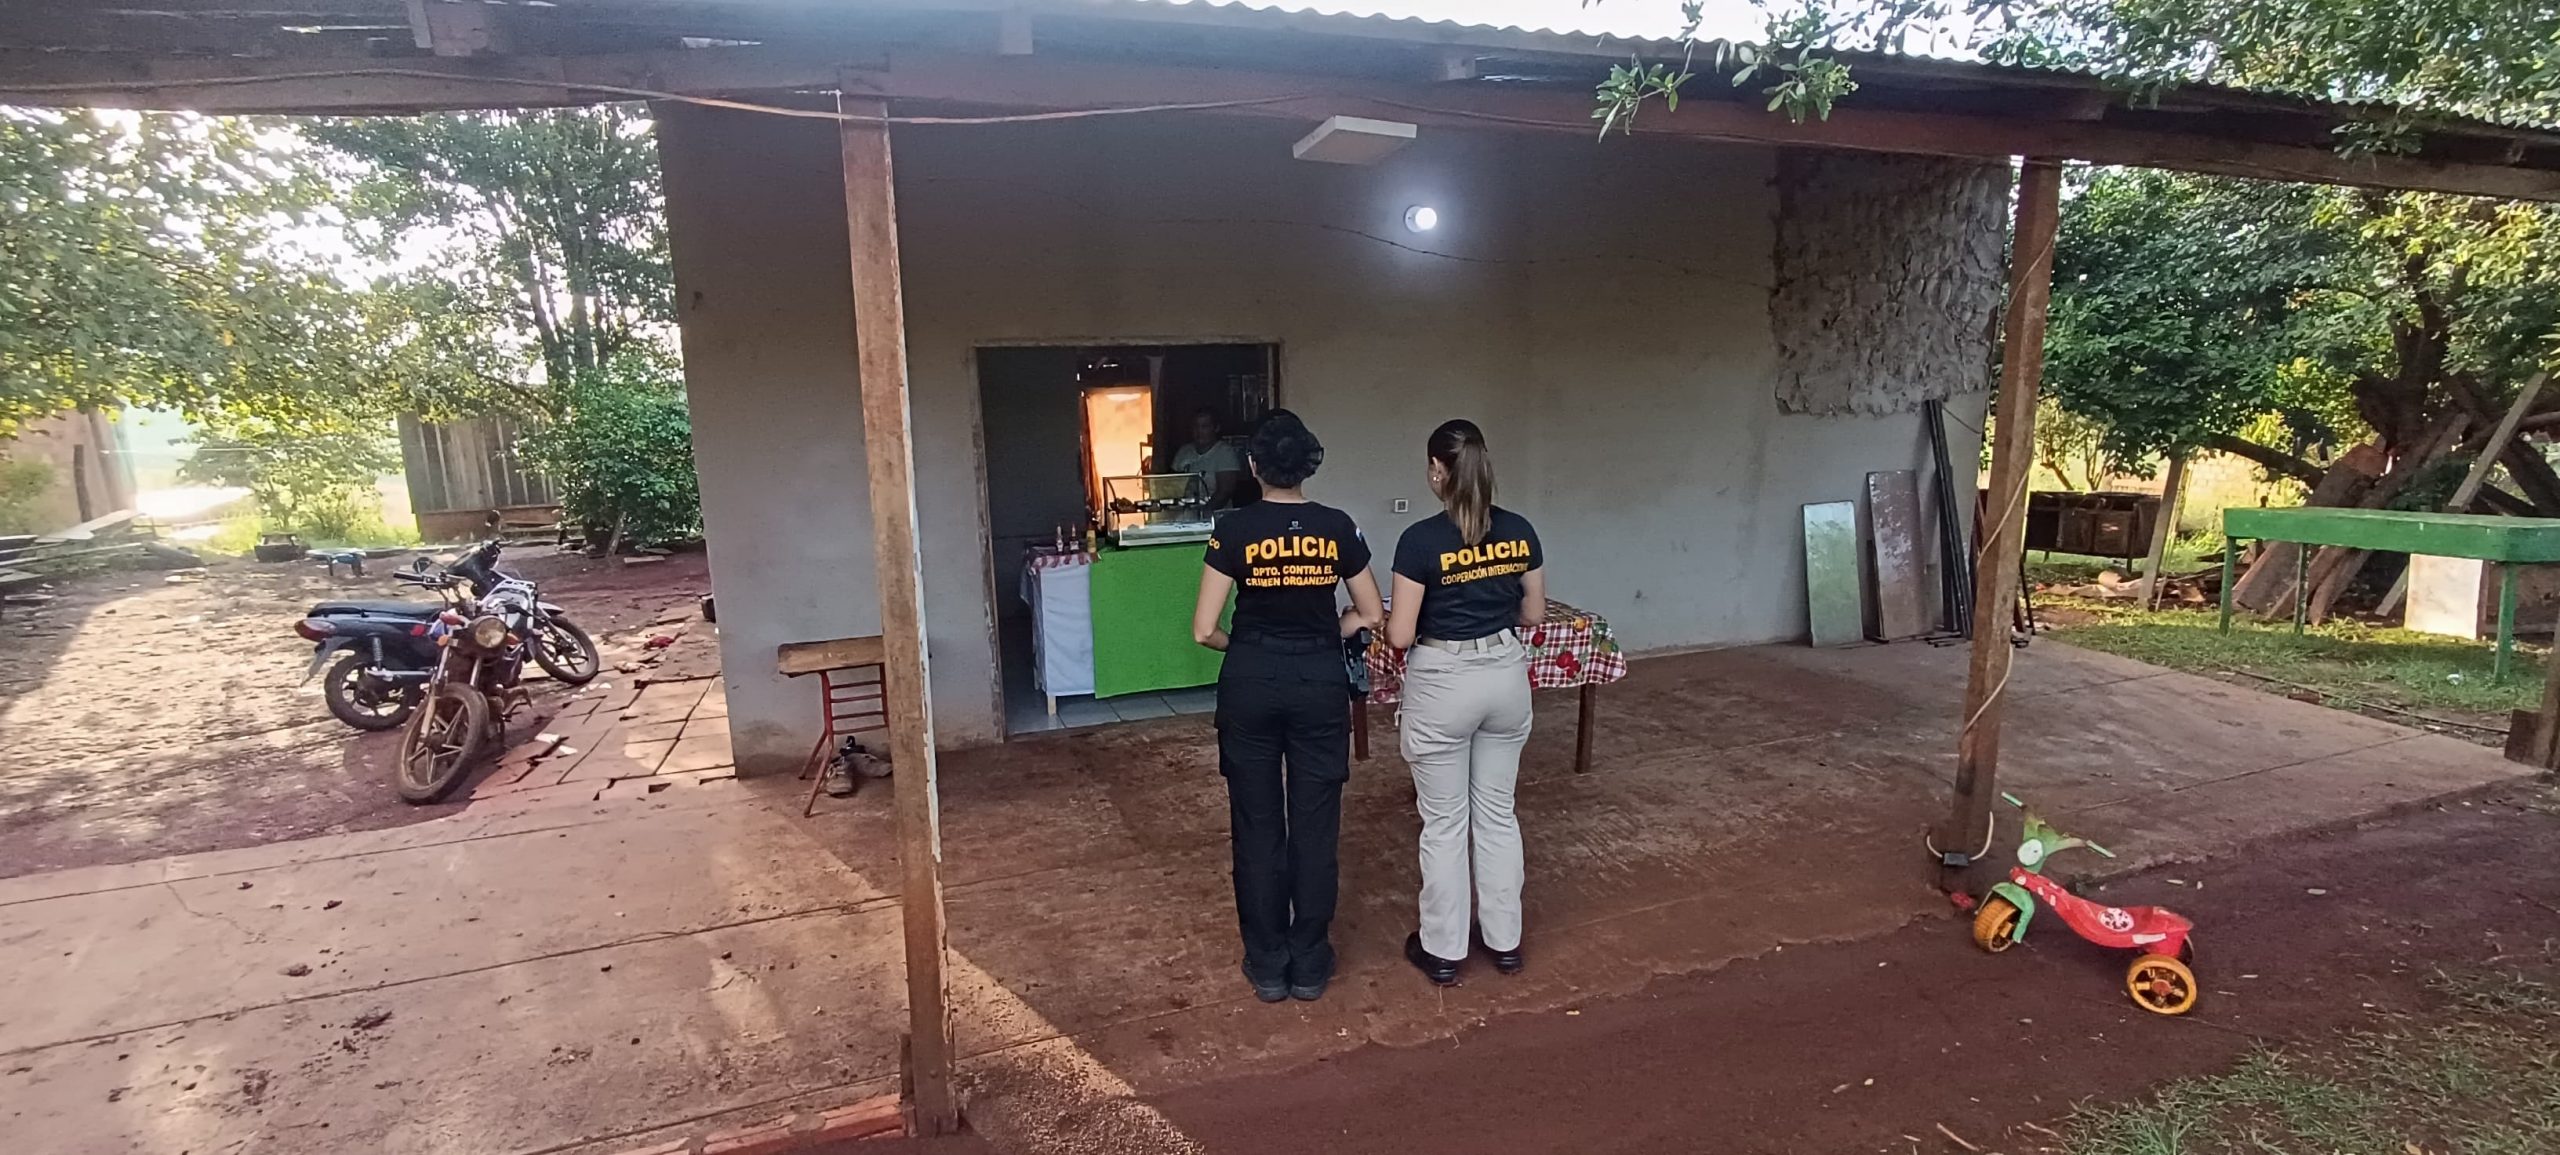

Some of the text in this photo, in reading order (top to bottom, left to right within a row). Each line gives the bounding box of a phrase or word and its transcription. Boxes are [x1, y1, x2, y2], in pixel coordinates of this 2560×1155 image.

[1245, 536, 1339, 564] POLICIA
[1440, 540, 1530, 571] POLICIA
[1245, 574, 1338, 587] CRIMEN ORGANIZADO
[1252, 565, 1333, 577] DPTO. CONTRA EL
